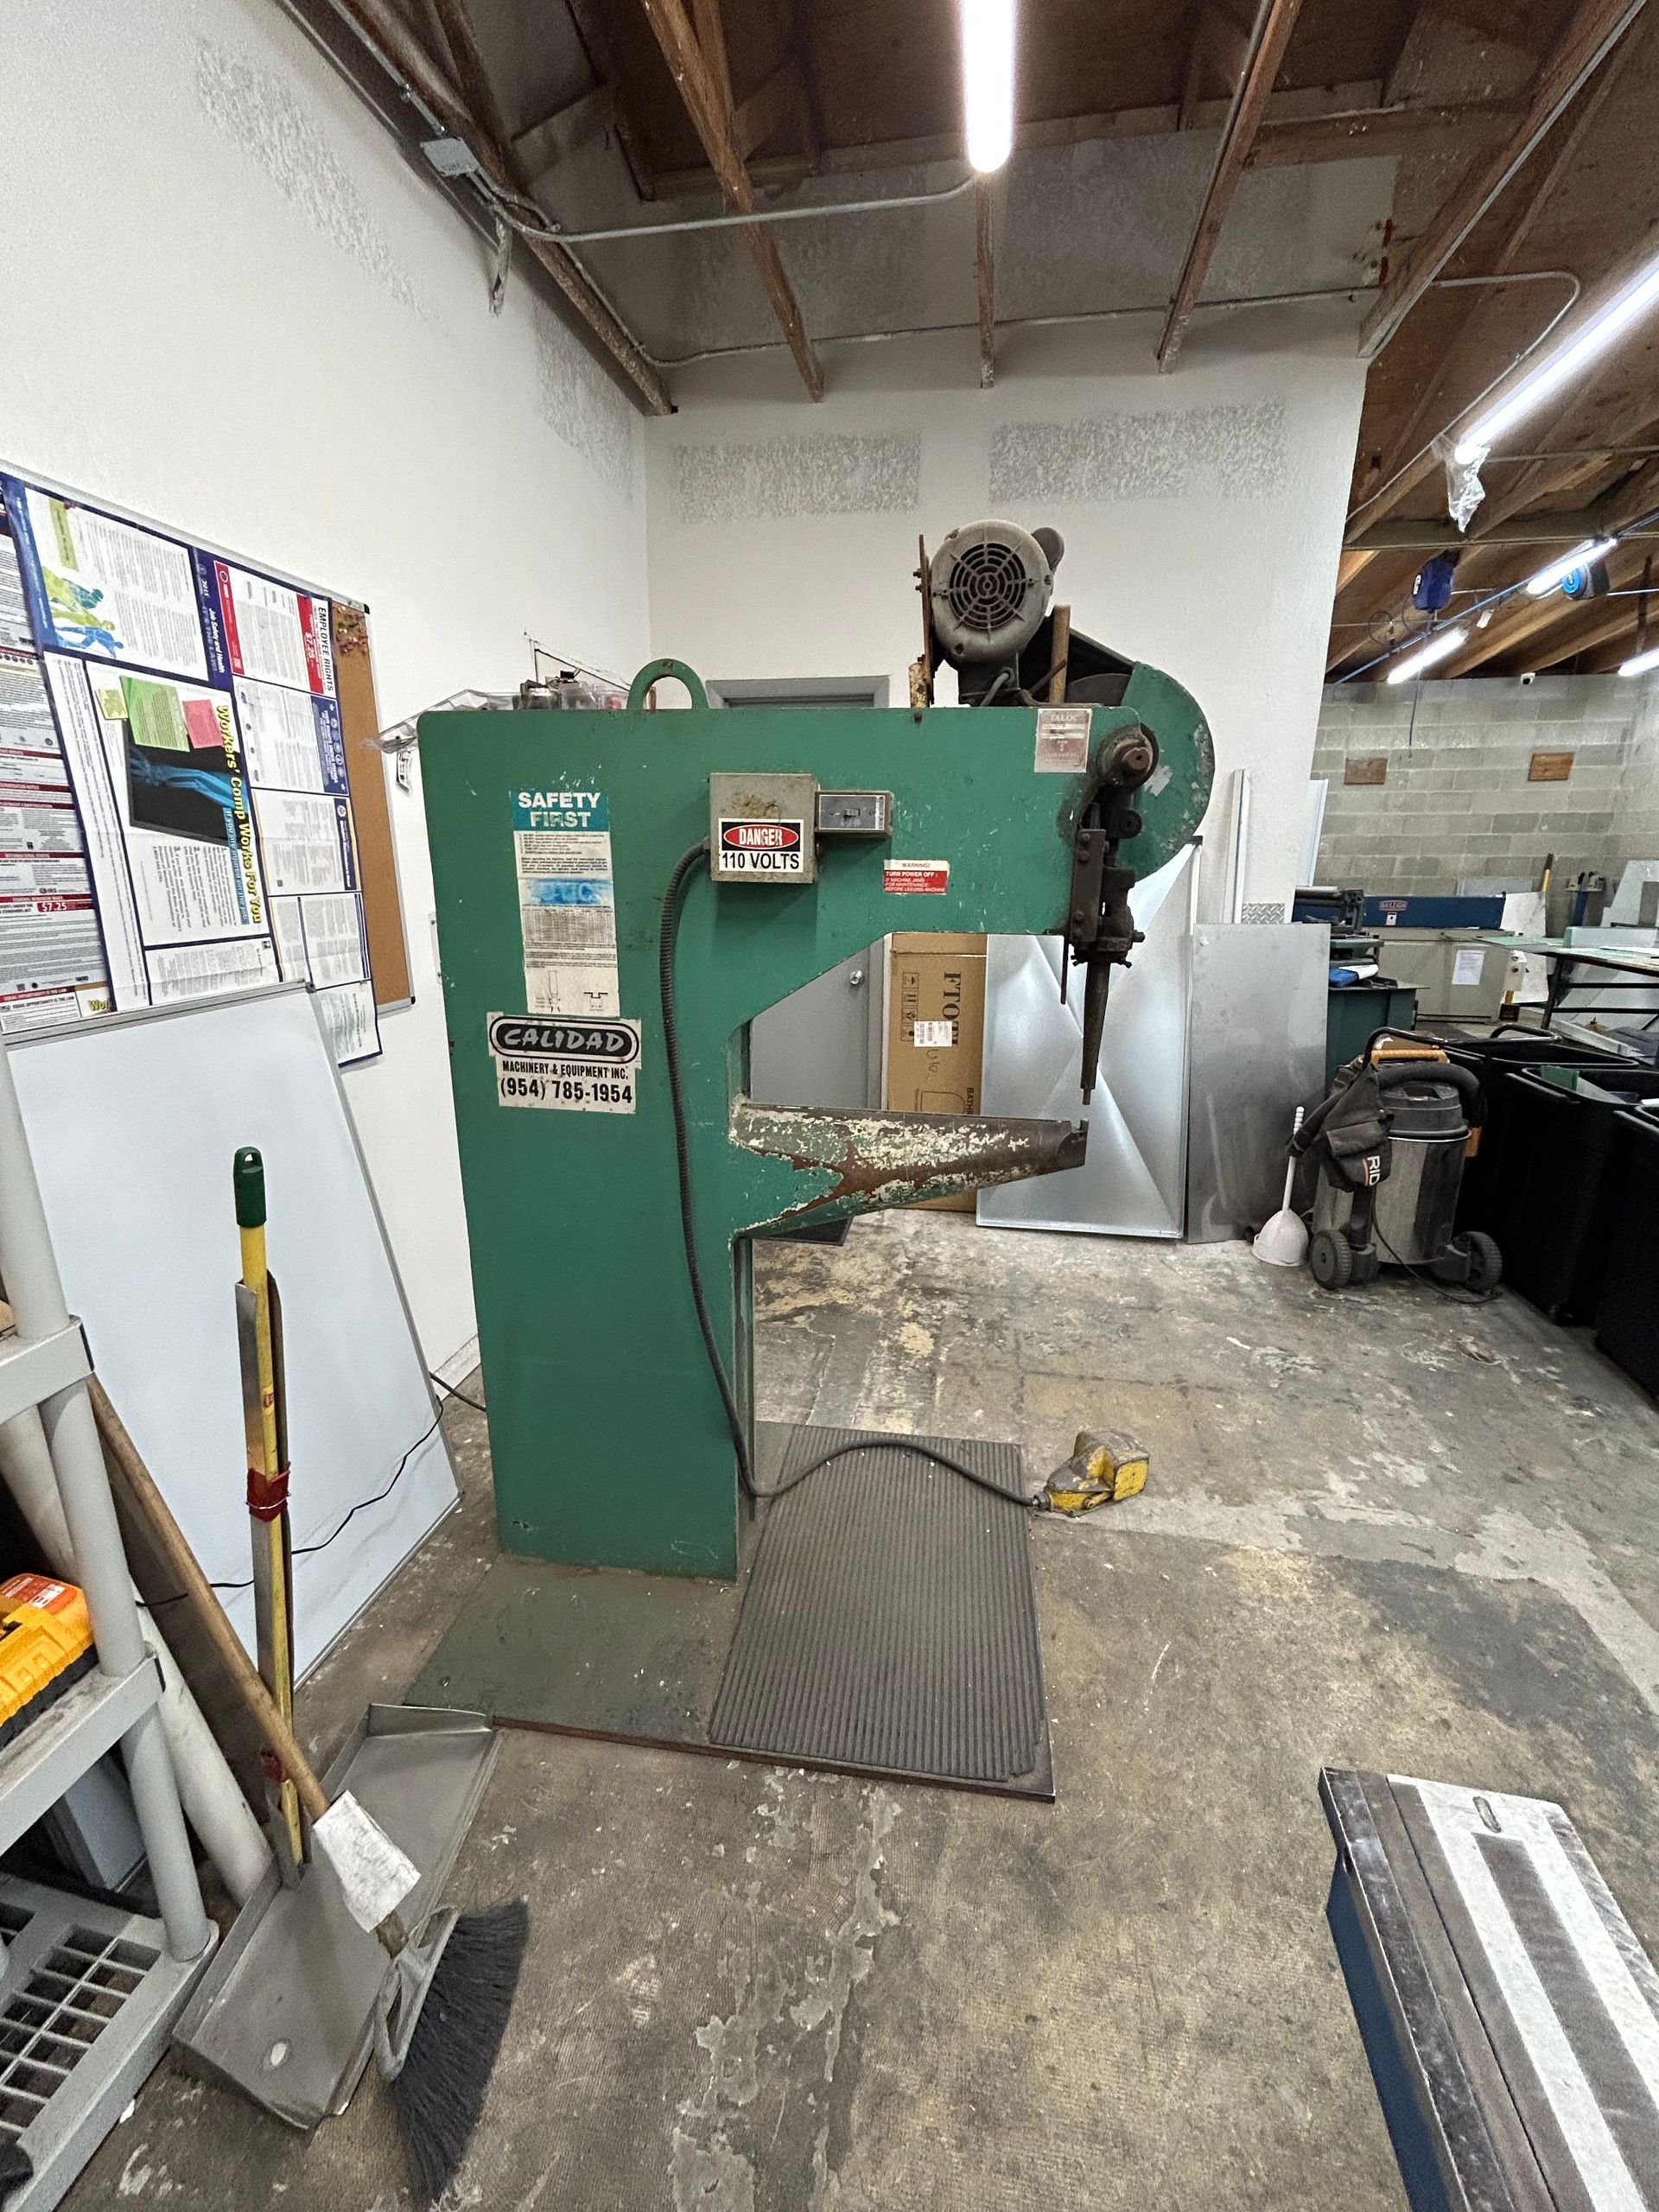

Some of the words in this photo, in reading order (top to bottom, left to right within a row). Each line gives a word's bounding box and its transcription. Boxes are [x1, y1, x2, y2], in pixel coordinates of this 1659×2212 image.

[318, 607, 329, 656] EMPLOYEE
[305, 632, 315, 659] $7.25
[323, 658, 334, 691] RIGHTS
[216, 704, 240, 774] Workers'
[230, 775, 248, 821] Comp
[518, 791, 601, 809] SAFETY
[530, 811, 591, 828] FIRST
[238, 823, 254, 870] Works
[739, 828, 783, 846] DANGER
[722, 852, 746, 869] 110
[750, 853, 799, 869] VOLTS
[245, 870, 258, 895] For
[41, 902, 67, 912] $7.25
[250, 895, 262, 924] You
[504, 1027, 625, 1052] CALIDAD
[502, 1060, 550, 1075] MACHINERY
[552, 1064, 558, 1075] &
[561, 1064, 609, 1078] EQUIPMENT
[611, 1067, 629, 1080] INC.
[500, 1077, 547, 1100] (954)
[551, 1080, 632, 1103] 785-1954
[1367, 1154, 1381, 1186] RID
